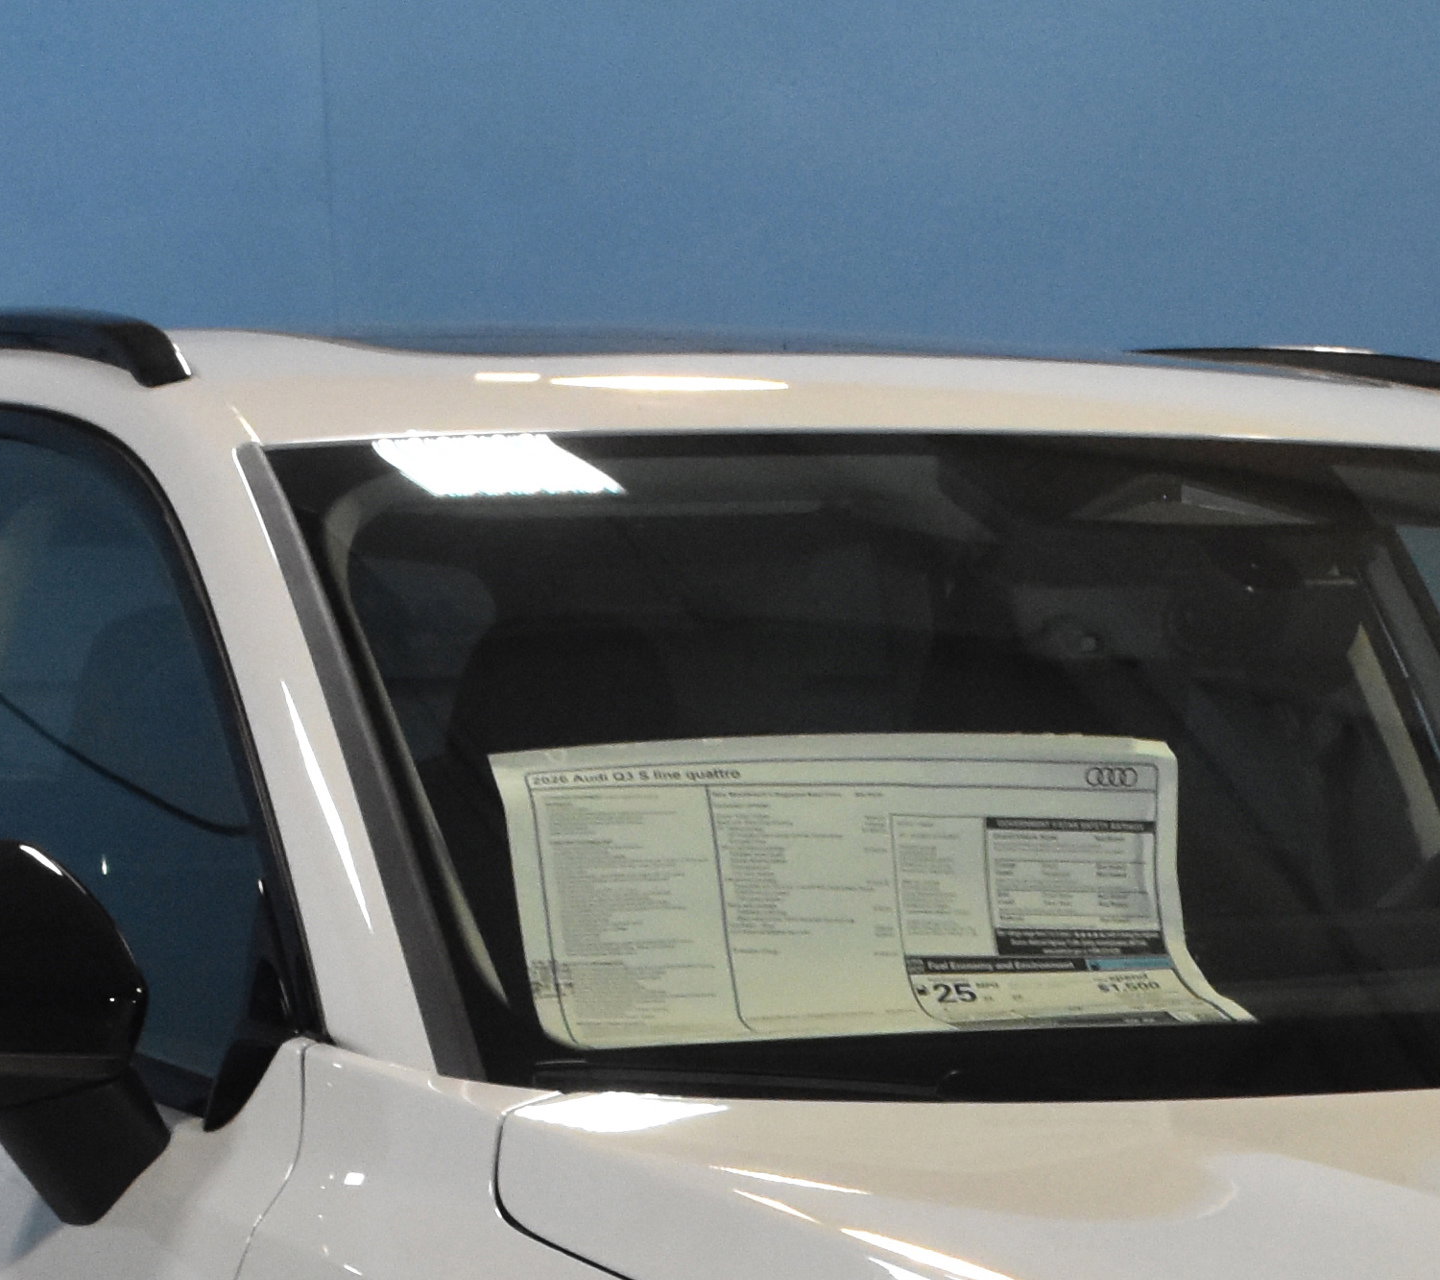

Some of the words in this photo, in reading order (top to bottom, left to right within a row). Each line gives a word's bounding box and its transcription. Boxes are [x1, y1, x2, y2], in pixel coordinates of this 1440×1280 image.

[533, 775, 569, 786] 2026
[573, 774, 608, 783] Audi
[612, 771, 635, 782] Q3
[638, 770, 651, 781] S
[653, 769, 681, 780] line
[685, 767, 741, 781] quattro
[933, 983, 977, 1003] 25
